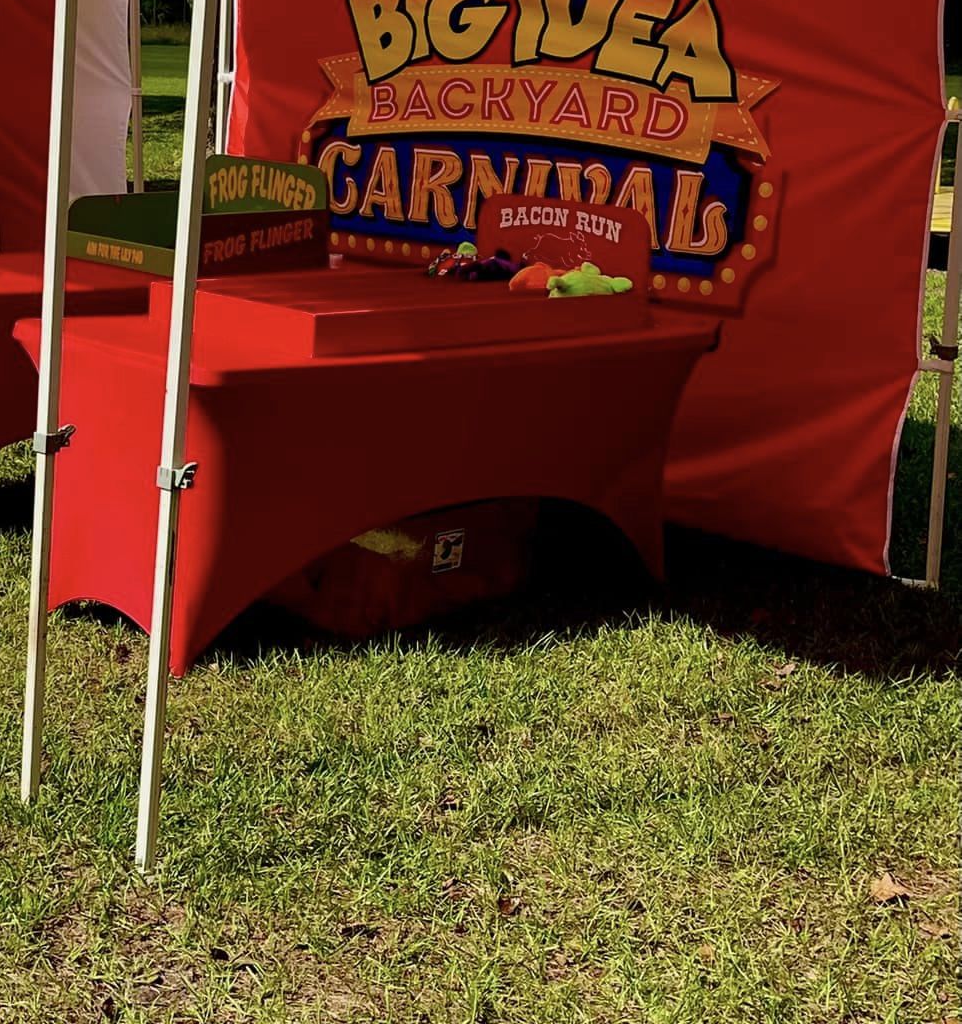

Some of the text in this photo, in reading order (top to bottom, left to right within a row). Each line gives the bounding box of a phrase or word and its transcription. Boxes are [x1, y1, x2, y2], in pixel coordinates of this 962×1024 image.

[368, 77, 690, 141] BACKYARD
[209, 164, 316, 210] FROG FLINGER
[203, 218, 314, 264] FROG FLINGER
[500, 206, 623, 243] BACON RUN
